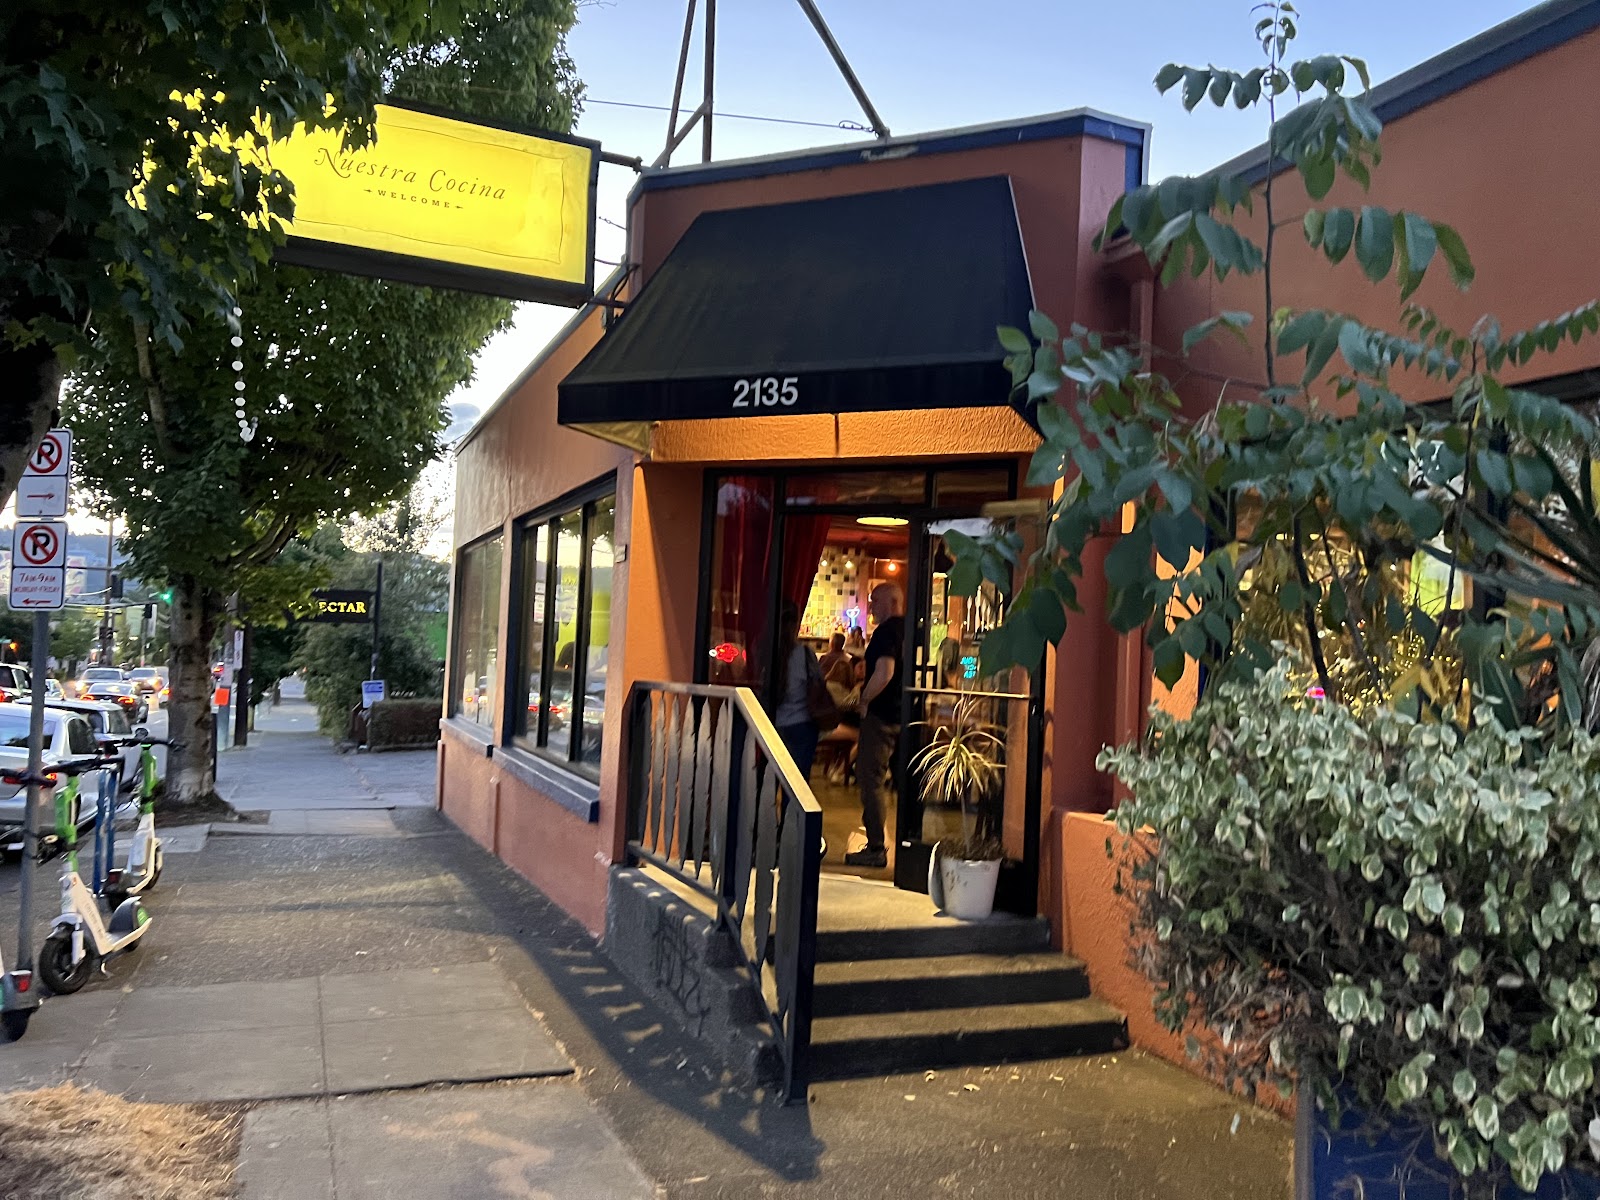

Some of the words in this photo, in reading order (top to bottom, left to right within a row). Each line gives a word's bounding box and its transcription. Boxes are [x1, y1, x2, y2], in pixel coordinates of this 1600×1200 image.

[313, 147, 417, 183] Nuestra
[429, 169, 506, 200] Cocina
[377, 189, 450, 208] WELCOME
[732, 376, 799, 408] 2135
[308, 601, 367, 614] ECTAR
